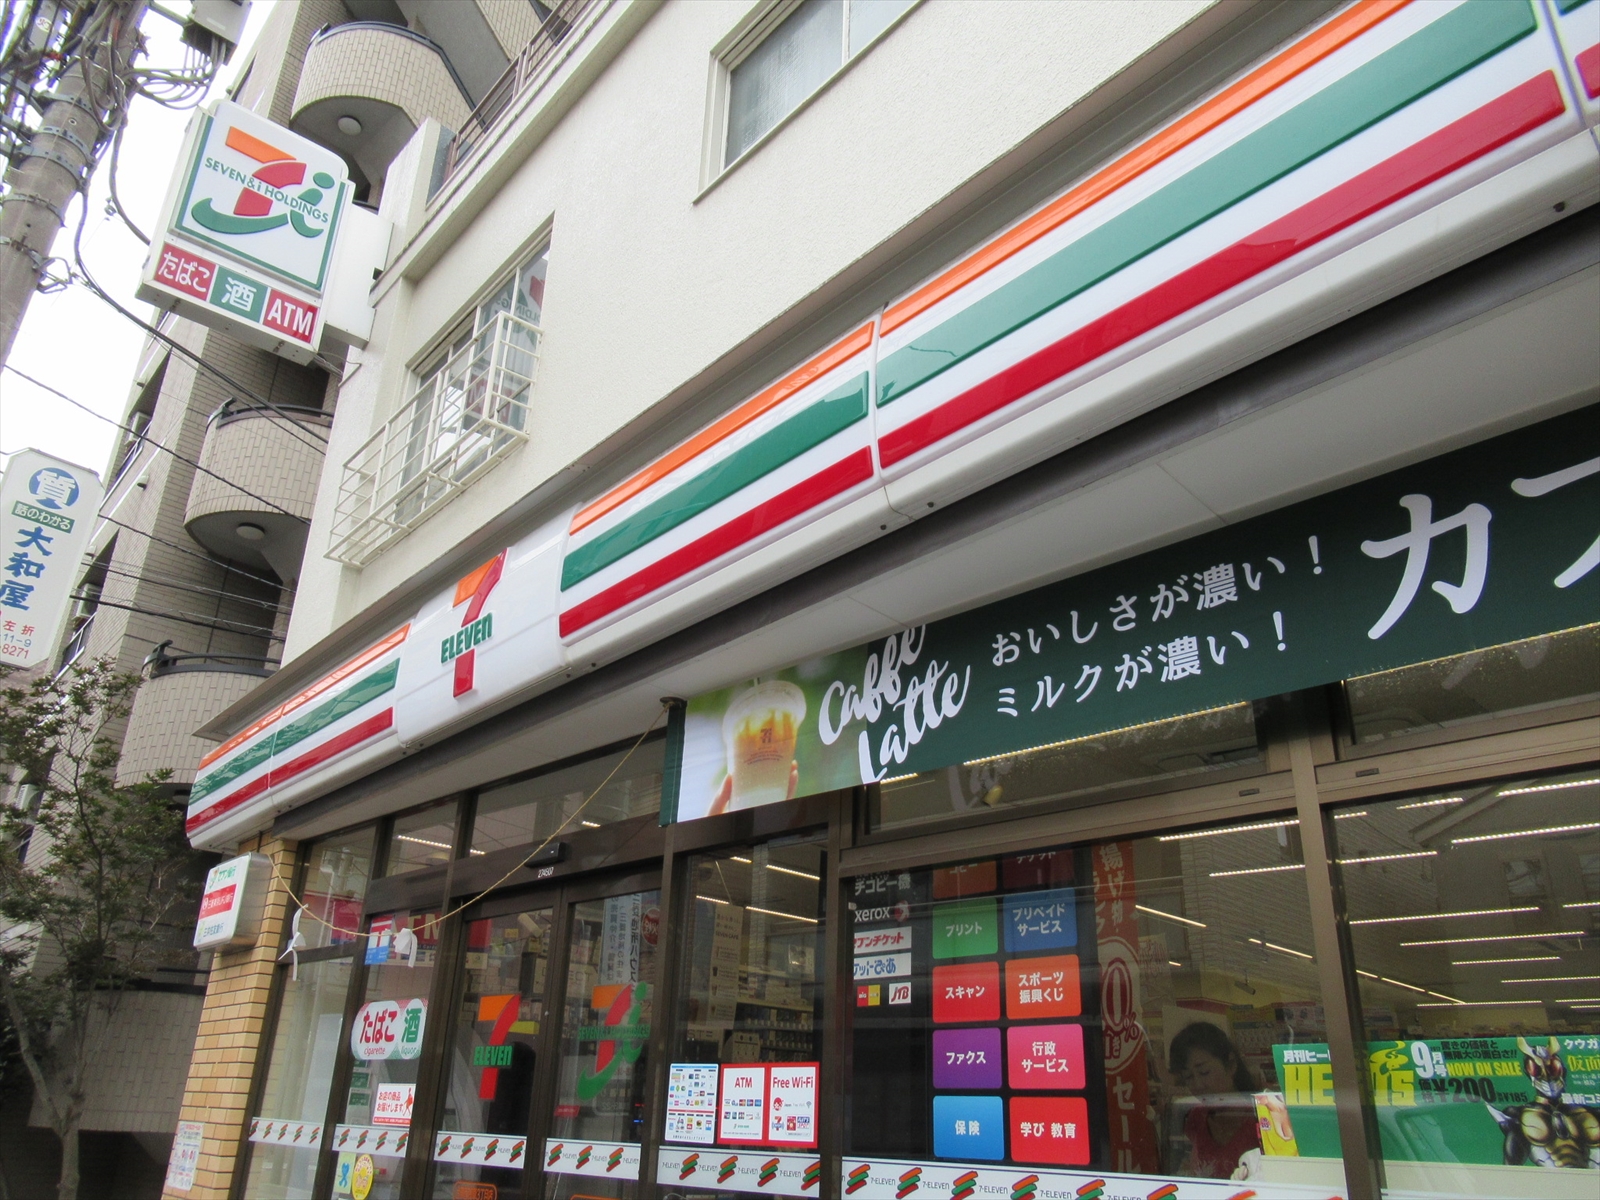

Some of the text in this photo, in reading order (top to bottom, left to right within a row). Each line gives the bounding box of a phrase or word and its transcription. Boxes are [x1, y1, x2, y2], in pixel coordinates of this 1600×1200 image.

[264, 185, 329, 224] HOLDINGS
[157, 252, 211, 293] たばこ
[221, 276, 257, 312] 酒
[267, 298, 314, 336] ATM
[36, 469, 77, 507] 質
[14, 503, 71, 531] 話のわかる
[1, 526, 54, 611] 大和屋
[0, 633, 32, 648] 11-9
[441, 612, 493, 664] ELEVEN
[0, 643, 30, 659] 8271
[858, 660, 970, 784] Latte
[854, 907, 890, 923] xerox
[1012, 903, 1065, 921] プリペイド
[946, 921, 982, 937] プリント
[1017, 920, 1062, 937] サービス
[1018, 971, 1064, 987] スポーツ
[945, 985, 985, 999] スキャン
[1019, 987, 1064, 1004] 振興くじ
[360, 1008, 397, 1045] たばこ
[402, 1008, 422, 1043] 酒
[1032, 1041, 1056, 1056] 行政
[1440, 1040, 1498, 1051] 驚きの価格と
[473, 1046, 514, 1066] ELEVEN
[946, 1051, 987, 1065] ファクス
[1021, 1057, 1069, 1073] サービス
[1446, 1061, 1522, 1077] NOW ON SALE
[735, 1077, 753, 1088] ATM
[773, 1076, 813, 1089] Free Wi-Fi
[955, 1120, 981, 1135] 保険
[1020, 1121, 1077, 1138] 学び 教育
[870, 1176, 896, 1186] 7-ELEVEN
[922, 1181, 950, 1190] 7-ELEVEN
[979, 1185, 1009, 1195] 7-ELEVEN
[1040, 1189, 1072, 1200] 7-ELEVEN
